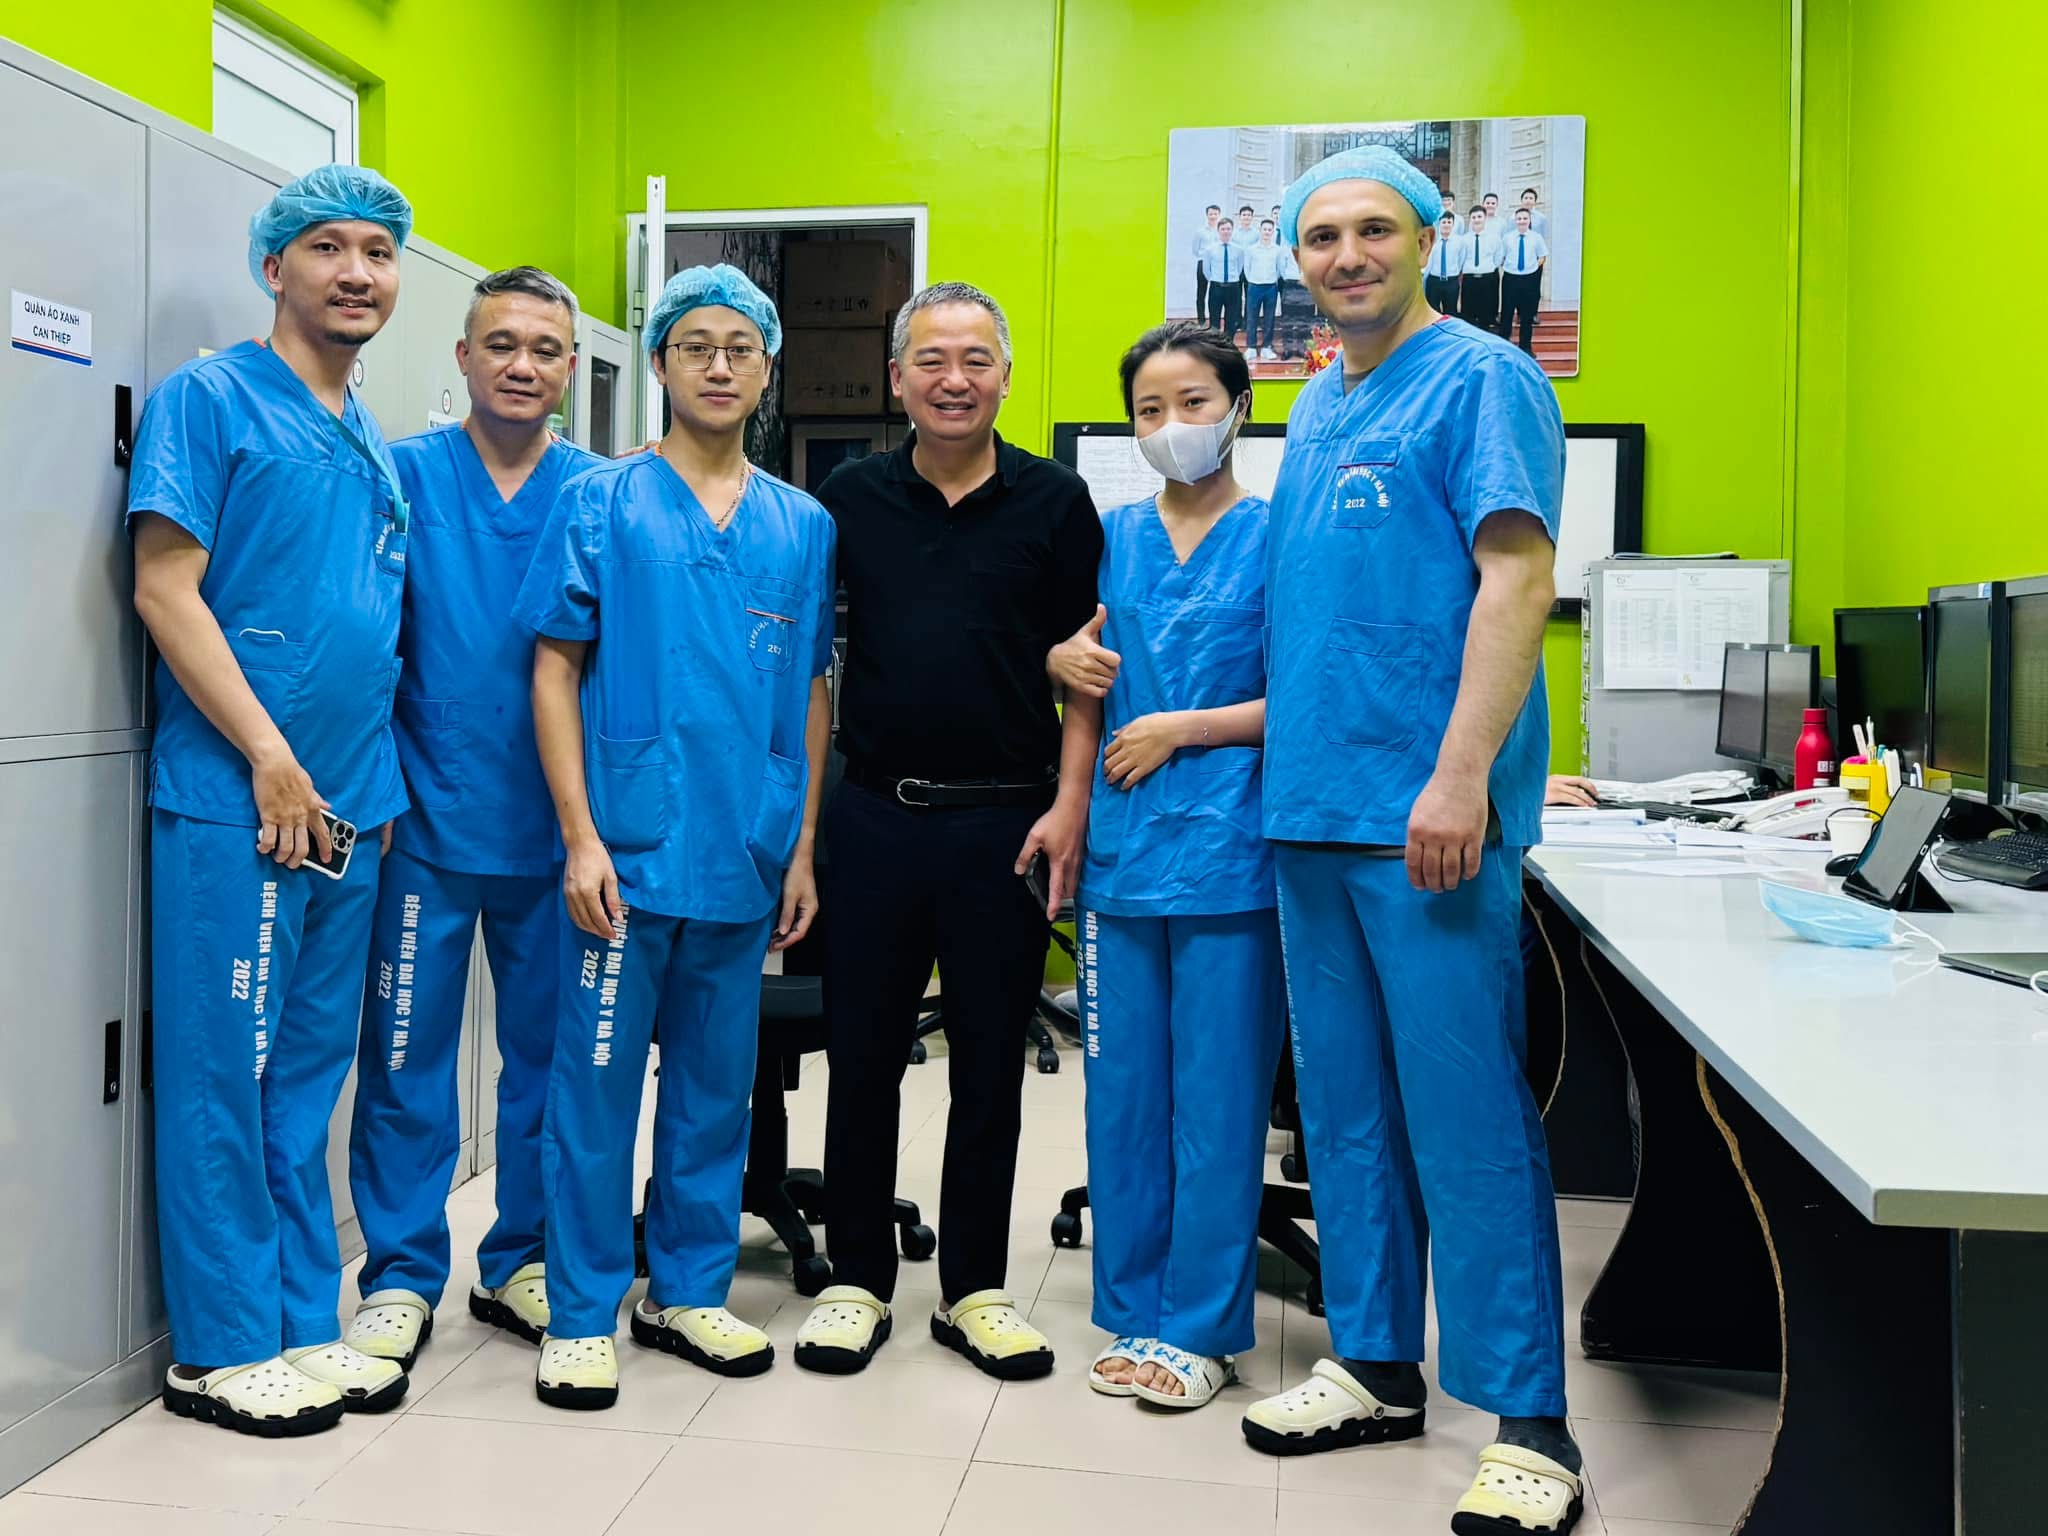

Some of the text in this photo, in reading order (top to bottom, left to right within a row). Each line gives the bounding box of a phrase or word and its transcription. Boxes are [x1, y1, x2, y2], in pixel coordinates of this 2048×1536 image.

[60, 310, 80, 327] XANH
[33, 325, 49, 340] CAN
[401, 894, 421, 929] BỆNH
[398, 931, 418, 960] VIỆN
[580, 949, 600, 990] 2022
[602, 951, 623, 976] ĐẠI
[231, 957, 251, 1001] 2022
[377, 959, 393, 1000] 2022
[394, 988, 413, 1016] HỌC
[599, 978, 619, 1006] HỌC
[599, 1009, 614, 1018] Y
[1087, 1001, 1098, 1010] Y
[394, 1018, 410, 1028] Y
[596, 1020, 614, 1040] HÀ
[591, 1042, 612, 1067] NỘI
